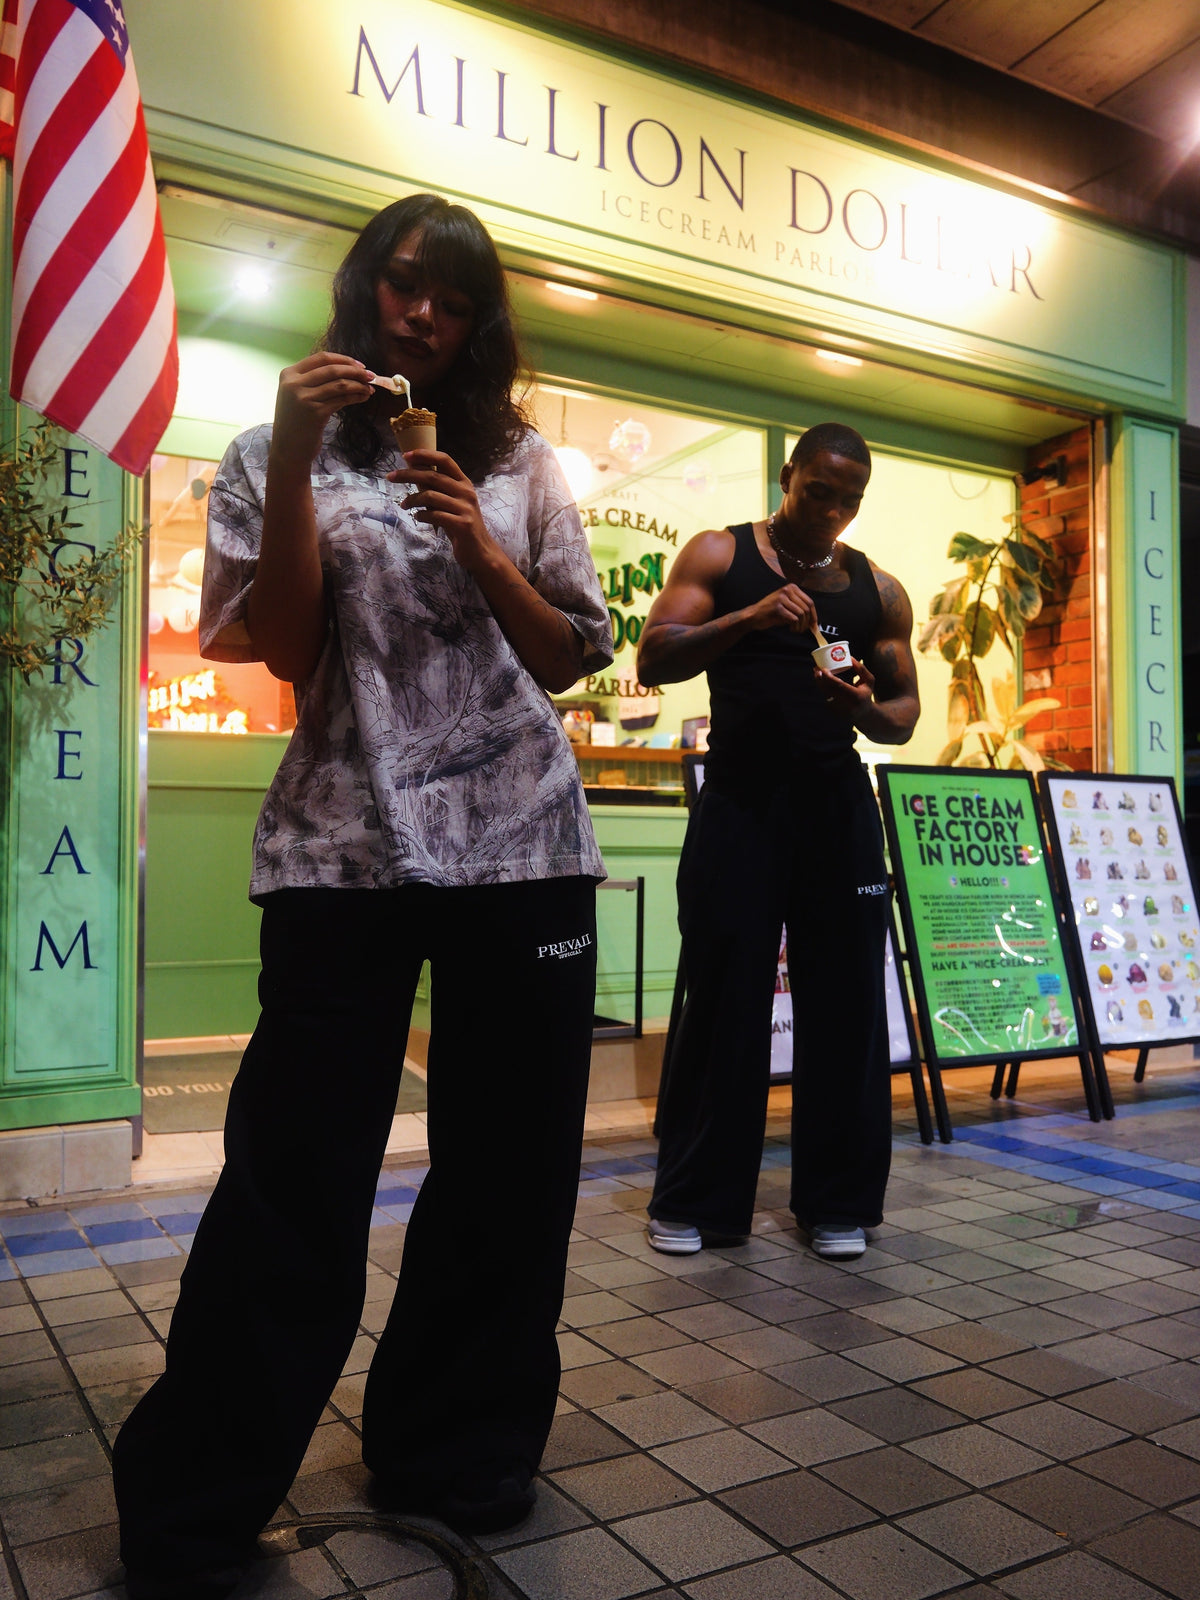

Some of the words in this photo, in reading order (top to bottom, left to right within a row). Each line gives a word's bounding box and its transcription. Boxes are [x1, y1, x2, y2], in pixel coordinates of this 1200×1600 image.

[346, 24, 749, 212] MILLION
[600, 190, 757, 253] ICECREAM
[605, 508, 678, 547] CREAM
[901, 793, 940, 817] ICE
[945, 795, 1025, 820] CREAM
[913, 818, 1019, 843] FACTORY
[918, 842, 944, 866] IN
[949, 843, 1030, 867] HOUSE
[932, 961, 958, 971] HAVE
[961, 960, 968, 970] A
[176, 1082, 224, 1094] YOU
